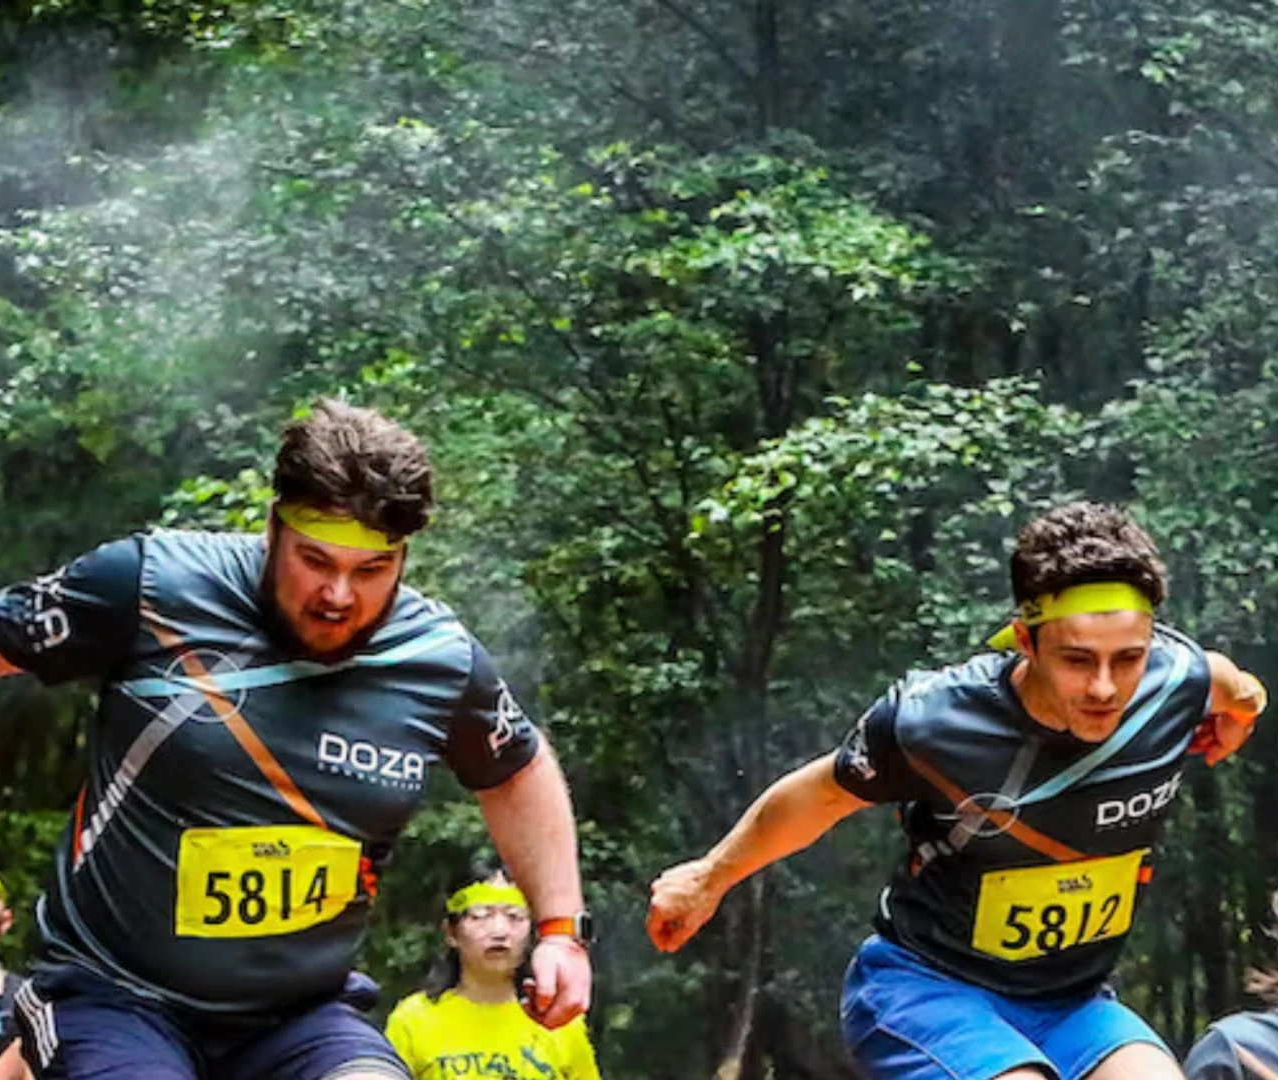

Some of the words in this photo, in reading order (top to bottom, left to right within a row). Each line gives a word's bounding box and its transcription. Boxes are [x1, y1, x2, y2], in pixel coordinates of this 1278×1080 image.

[318, 732, 425, 781] DOZA
[202, 865, 329, 925] 5814
[1000, 893, 1121, 951] 5812
